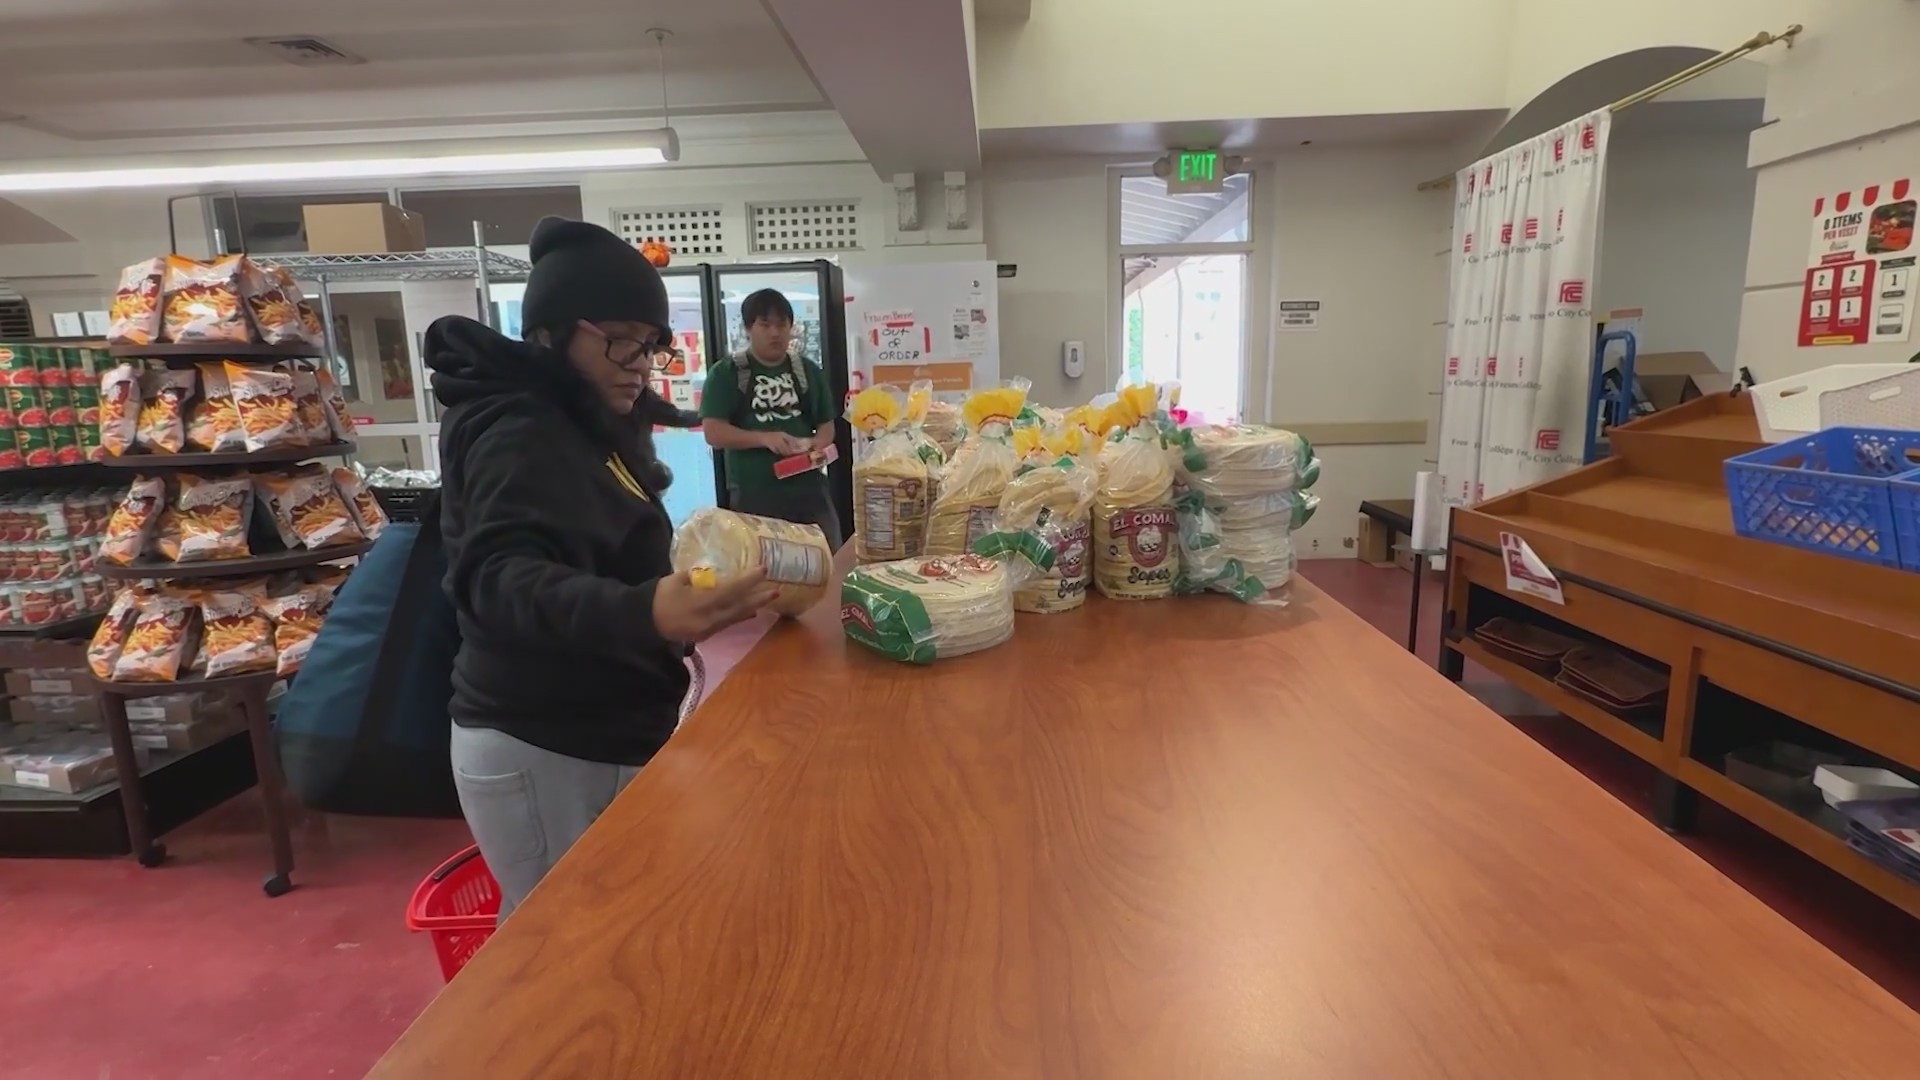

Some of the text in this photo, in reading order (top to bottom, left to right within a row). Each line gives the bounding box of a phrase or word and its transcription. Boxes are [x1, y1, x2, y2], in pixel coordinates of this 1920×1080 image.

[1180, 153, 1217, 181] EXIT
[1823, 212, 1863, 231] 8 ITEMS
[1823, 226, 1859, 241] PER VISIT
[1818, 269, 1856, 286] 2 2
[1892, 274, 1898, 286] 1
[1817, 304, 1824, 316] 3
[878, 350, 920, 361] ORDER
[1113, 519, 1130, 531] EL
[1127, 566, 1172, 586] Sopes
